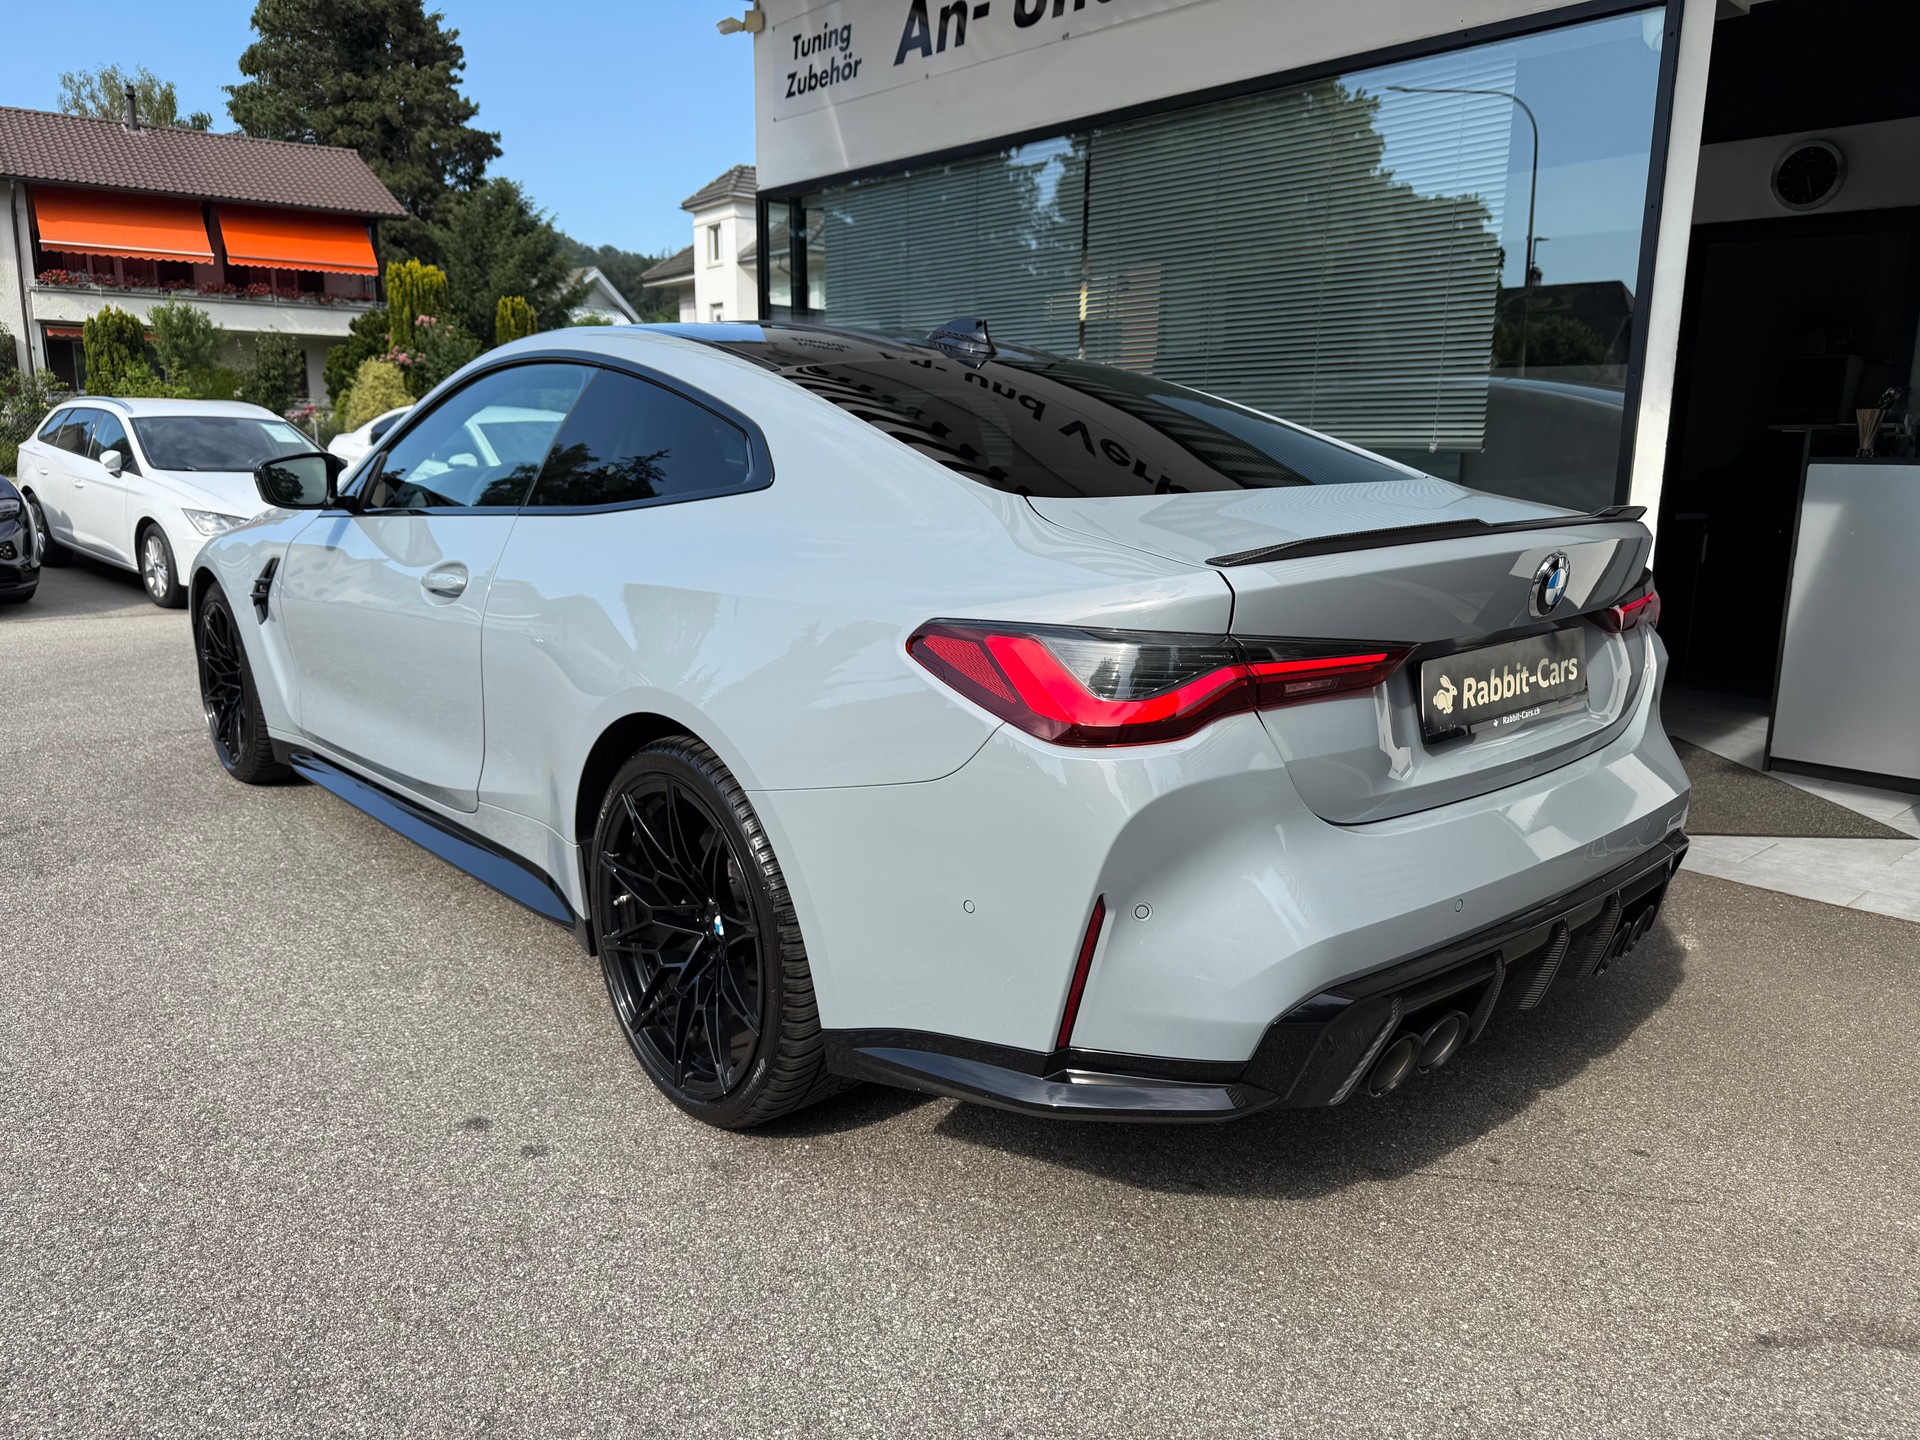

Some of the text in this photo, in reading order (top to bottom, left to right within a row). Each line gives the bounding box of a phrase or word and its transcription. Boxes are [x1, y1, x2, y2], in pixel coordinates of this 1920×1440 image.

[793, 22, 852, 60] Tuning
[893, 0, 990, 67] An-
[785, 52, 862, 99] Zubehör
[1462, 657, 1578, 710] Rabbit-Cars
[1502, 707, 1540, 725] Rabbit-Cars.ch
